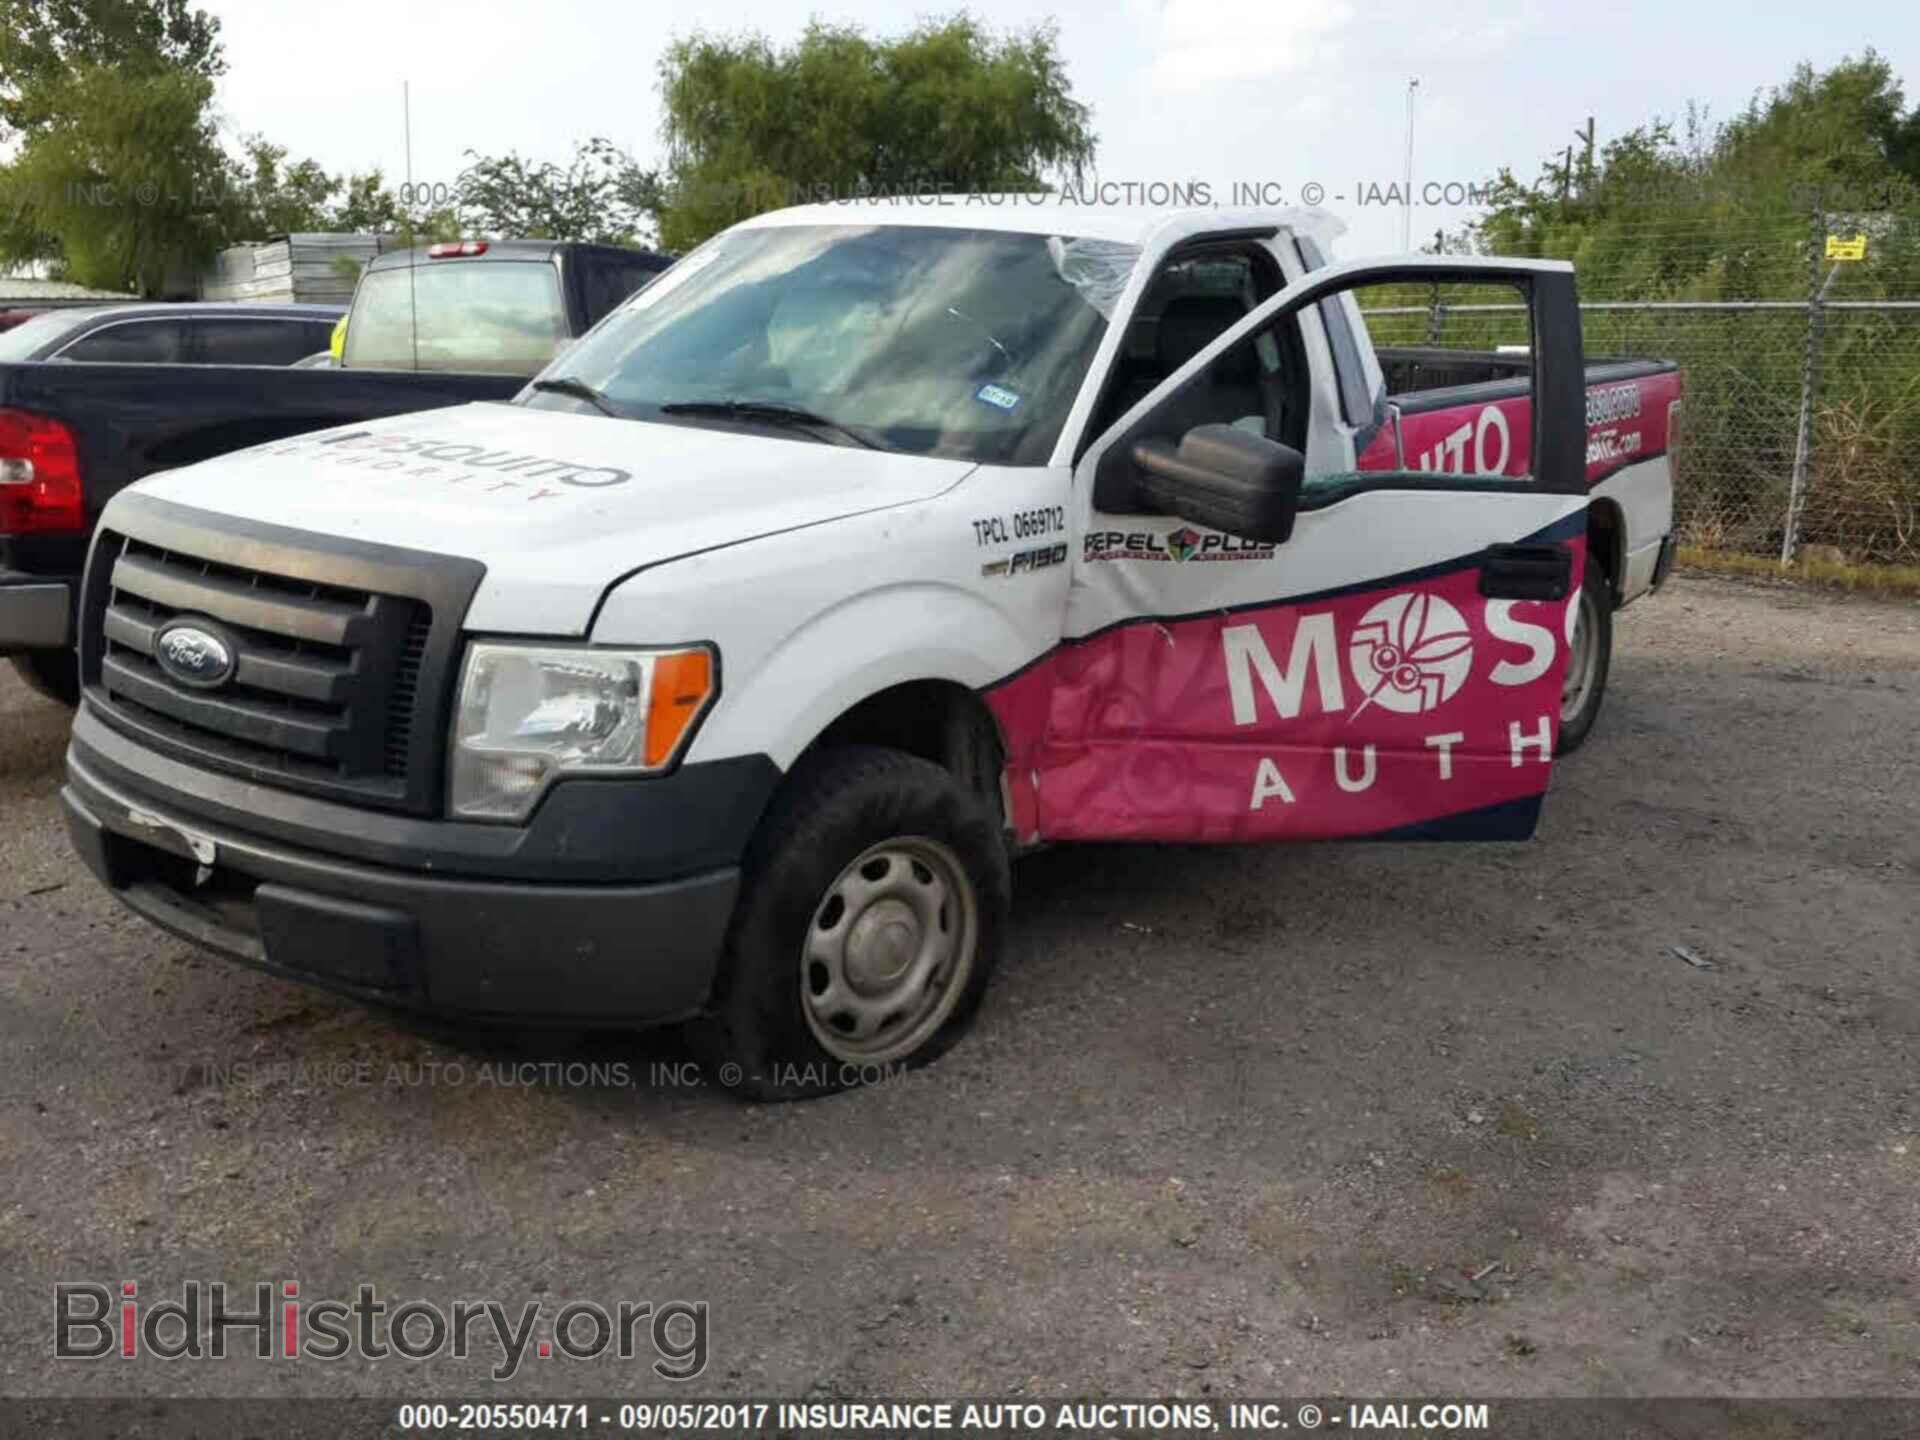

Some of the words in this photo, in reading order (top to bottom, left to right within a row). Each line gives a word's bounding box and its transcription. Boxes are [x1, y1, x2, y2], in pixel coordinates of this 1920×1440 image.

[972, 516, 1009, 547] TPCL
[1014, 505, 1065, 539] 0669712
[168, 634, 208, 669] Ford
[1249, 715, 1553, 811] AUTH
